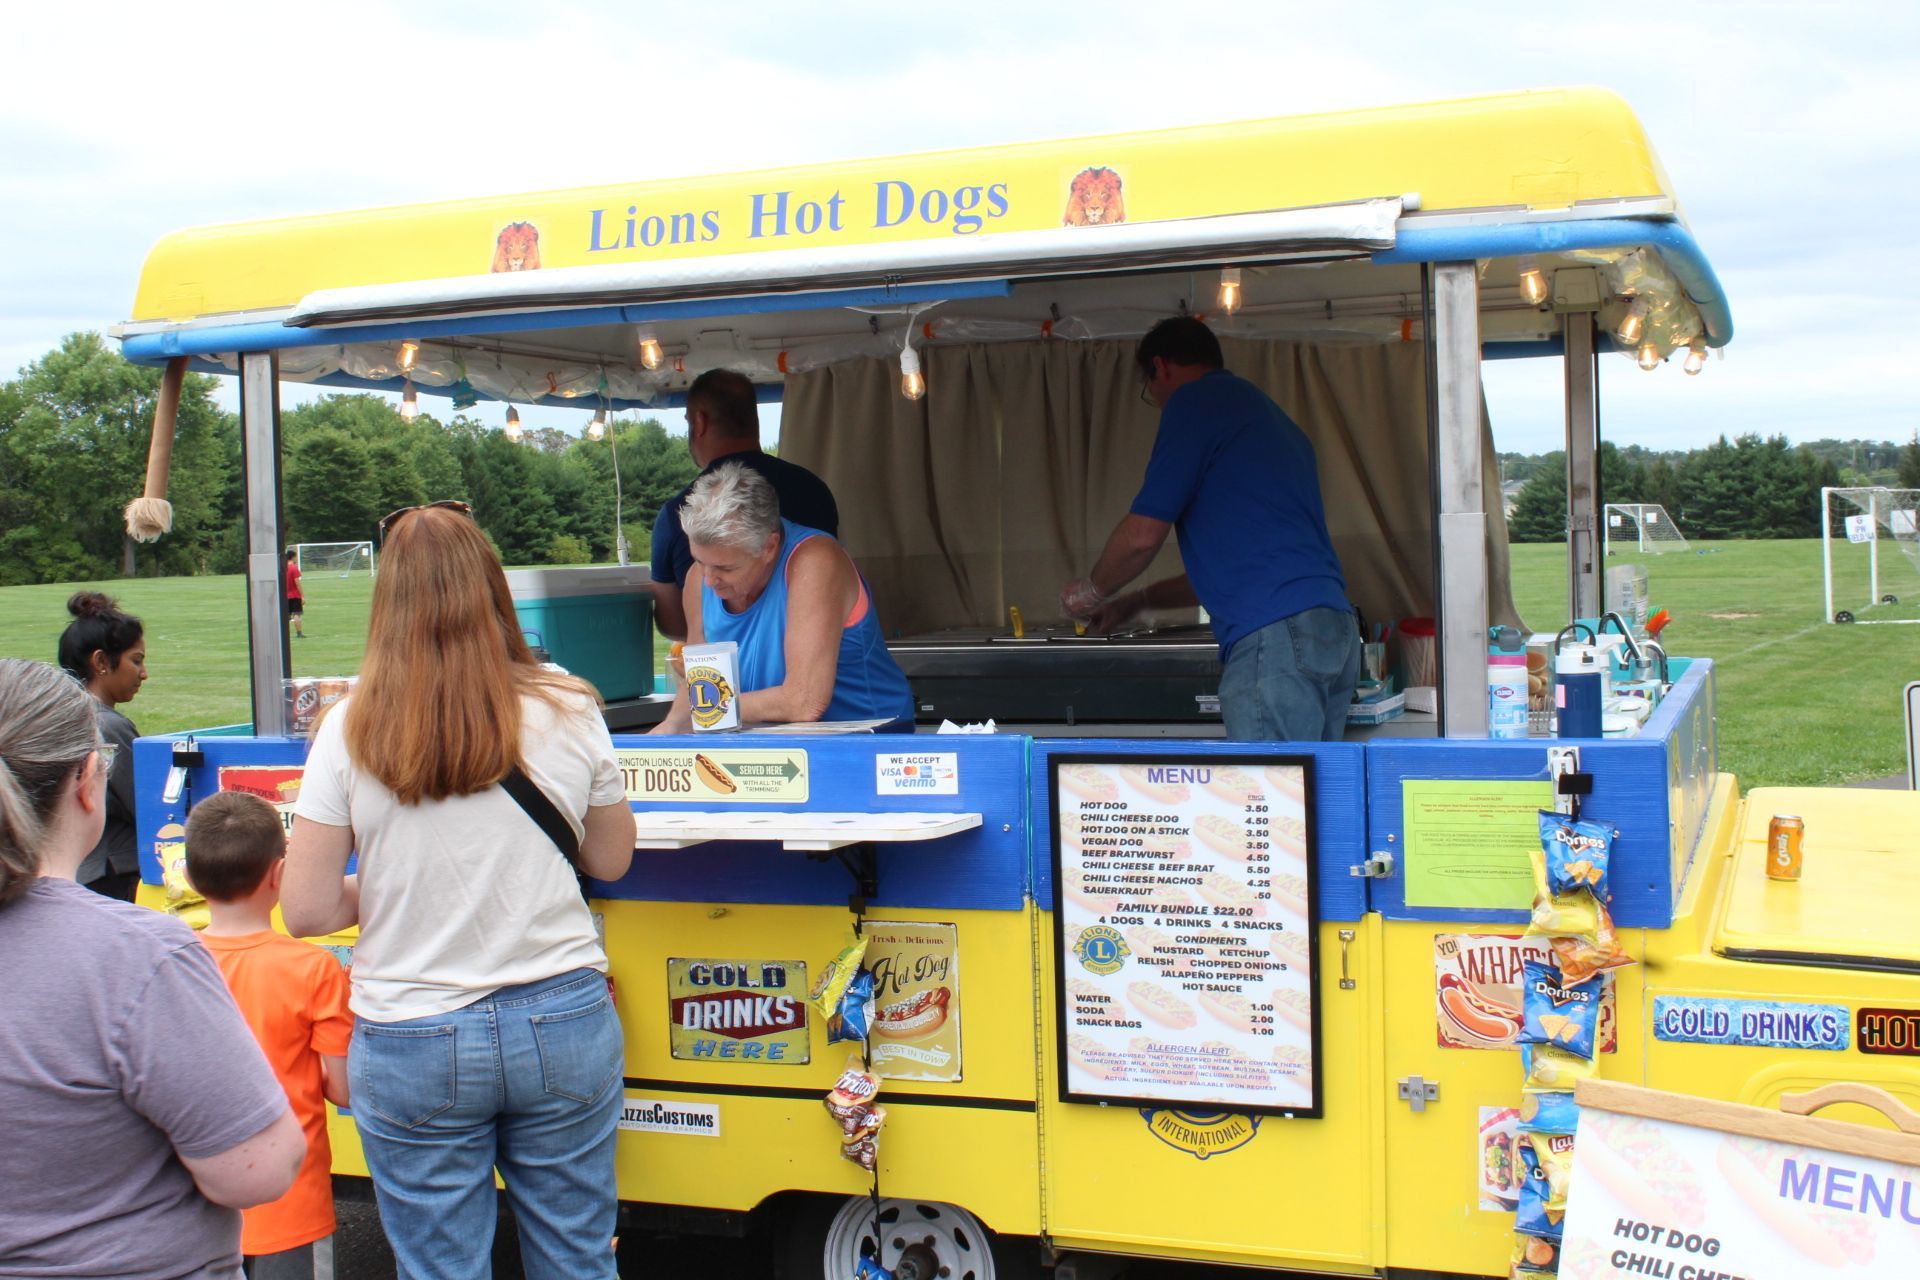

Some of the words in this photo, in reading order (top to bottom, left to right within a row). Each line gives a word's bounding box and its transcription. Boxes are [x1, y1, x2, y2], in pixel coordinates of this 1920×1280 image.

[586, 205, 720, 252] Lions
[747, 191, 846, 239] Hot
[870, 179, 1009, 235] Dogs
[695, 685, 713, 707] L
[618, 758, 650, 767] RINGTON
[652, 758, 672, 767] LIONS
[674, 758, 693, 767] CLUB
[740, 765, 764, 775] SERVED
[765, 766, 783, 775] HERE
[880, 768, 901, 776] VISA
[1147, 768, 1211, 784] MENU
[621, 769, 639, 792] OT
[645, 769, 691, 792] DOGS
[895, 779, 936, 787] venmo
[1080, 802, 1102, 810] HOT
[1104, 802, 1127, 810] DOG
[1245, 805, 1268, 813] 3.50
[1081, 814, 1109, 822] CHILI
[1111, 815, 1153, 823] CHEESE
[1155, 815, 1179, 823] DOG
[1245, 817, 1268, 825] 4.50
[1081, 826, 1103, 834] HOT
[1105, 826, 1129, 834] DOG
[1130, 826, 1146, 834] ON
[1148, 827, 1156, 835] A
[1158, 827, 1190, 835] STICK
[1082, 838, 1118, 846] VEGAN
[1119, 838, 1143, 847] DOG
[1246, 841, 1269, 850] 3.50
[1556, 830, 1606, 849] Doritos
[1082, 850, 1108, 858] BEEF
[1109, 850, 1175, 859] BRATWURST
[1246, 854, 1270, 862] 4.50
[1082, 862, 1111, 870] CHILI
[1113, 862, 1155, 871] CHEESE
[1187, 864, 1215, 873] BRAT
[1247, 866, 1270, 874] 5.50
[1083, 874, 1111, 883] CHILI
[1113, 875, 1155, 884] CHEESE
[1157, 876, 1203, 885] NACHOS
[1247, 879, 1271, 887] 4.25
[1083, 886, 1154, 896] SAUERKRAUT
[1254, 892, 1272, 900] .50
[1116, 903, 1158, 914] FAMILY
[1160, 905, 1208, 915] BUNDLE
[1213, 905, 1253, 916] $22.00
[1551, 898, 1577, 907] Classic
[1099, 916, 1106, 925] 4
[1111, 916, 1144, 926] DOGS
[1154, 918, 1161, 926] 4
[1166, 918, 1212, 928] DRINKS
[1222, 920, 1229, 929] 4
[1234, 920, 1283, 931] SNACKS
[873, 935, 896, 943] Fresh
[906, 936, 944, 944] Delicious
[1085, 927, 1119, 938] LIONS
[1175, 935, 1248, 946] CONDIMENTS
[1096, 942, 1110, 958] L
[1153, 946, 1204, 956] MUSTARD
[1219, 949, 1271, 958] KETCHUP
[1437, 941, 1459, 956] YO!
[1137, 957, 1174, 966] RELISH
[1190, 959, 1242, 969] CHOPPED
[1244, 961, 1287, 971] ONIONS
[689, 962, 787, 988] COLD
[871, 952, 910, 999] Hot
[914, 954, 949, 982] Dog
[1161, 969, 1214, 980] JALAPEÑO
[1216, 972, 1264, 982] PEPPERS
[1183, 983, 1205, 992] HOT
[1206, 984, 1242, 993] SAUCE
[1536, 982, 1589, 1001] Doritos
[1075, 994, 1111, 1003] WATER
[1251, 1004, 1274, 1012] 1.00
[682, 995, 795, 1030] DRINKS
[1076, 1006, 1105, 1015] SODA
[1251, 1016, 1274, 1024] 2.00
[1076, 1018, 1112, 1027] SNACK
[1114, 1020, 1142, 1029] BAGS
[1251, 1028, 1274, 1036] 1.00
[1664, 1006, 1730, 1038] COLD
[1742, 1009, 1838, 1043] DRINKS
[692, 1039, 789, 1059] HERE
[881, 1045, 904, 1055] BEST
[908, 1049, 917, 1057] IN
[920, 1053, 946, 1065] TOWN
[1146, 1043, 1197, 1054] ALLERGEN
[1200, 1047, 1230, 1056] ALERT
[837, 1071, 874, 1096] Fritos
[1132, 1077, 1171, 1085] INGREDIENT
[620, 1122, 669, 1130] AUTOMOTIVE
[673, 1126, 712, 1134] GRAPHICS
[1157, 1116, 1247, 1146] INTERNATIONAL
[1551, 1136, 1575, 1153] Lay
[1613, 1218, 1673, 1247] HOT
[1668, 1229, 1722, 1257] DOG
[1610, 1250, 1675, 1280] CHILI
